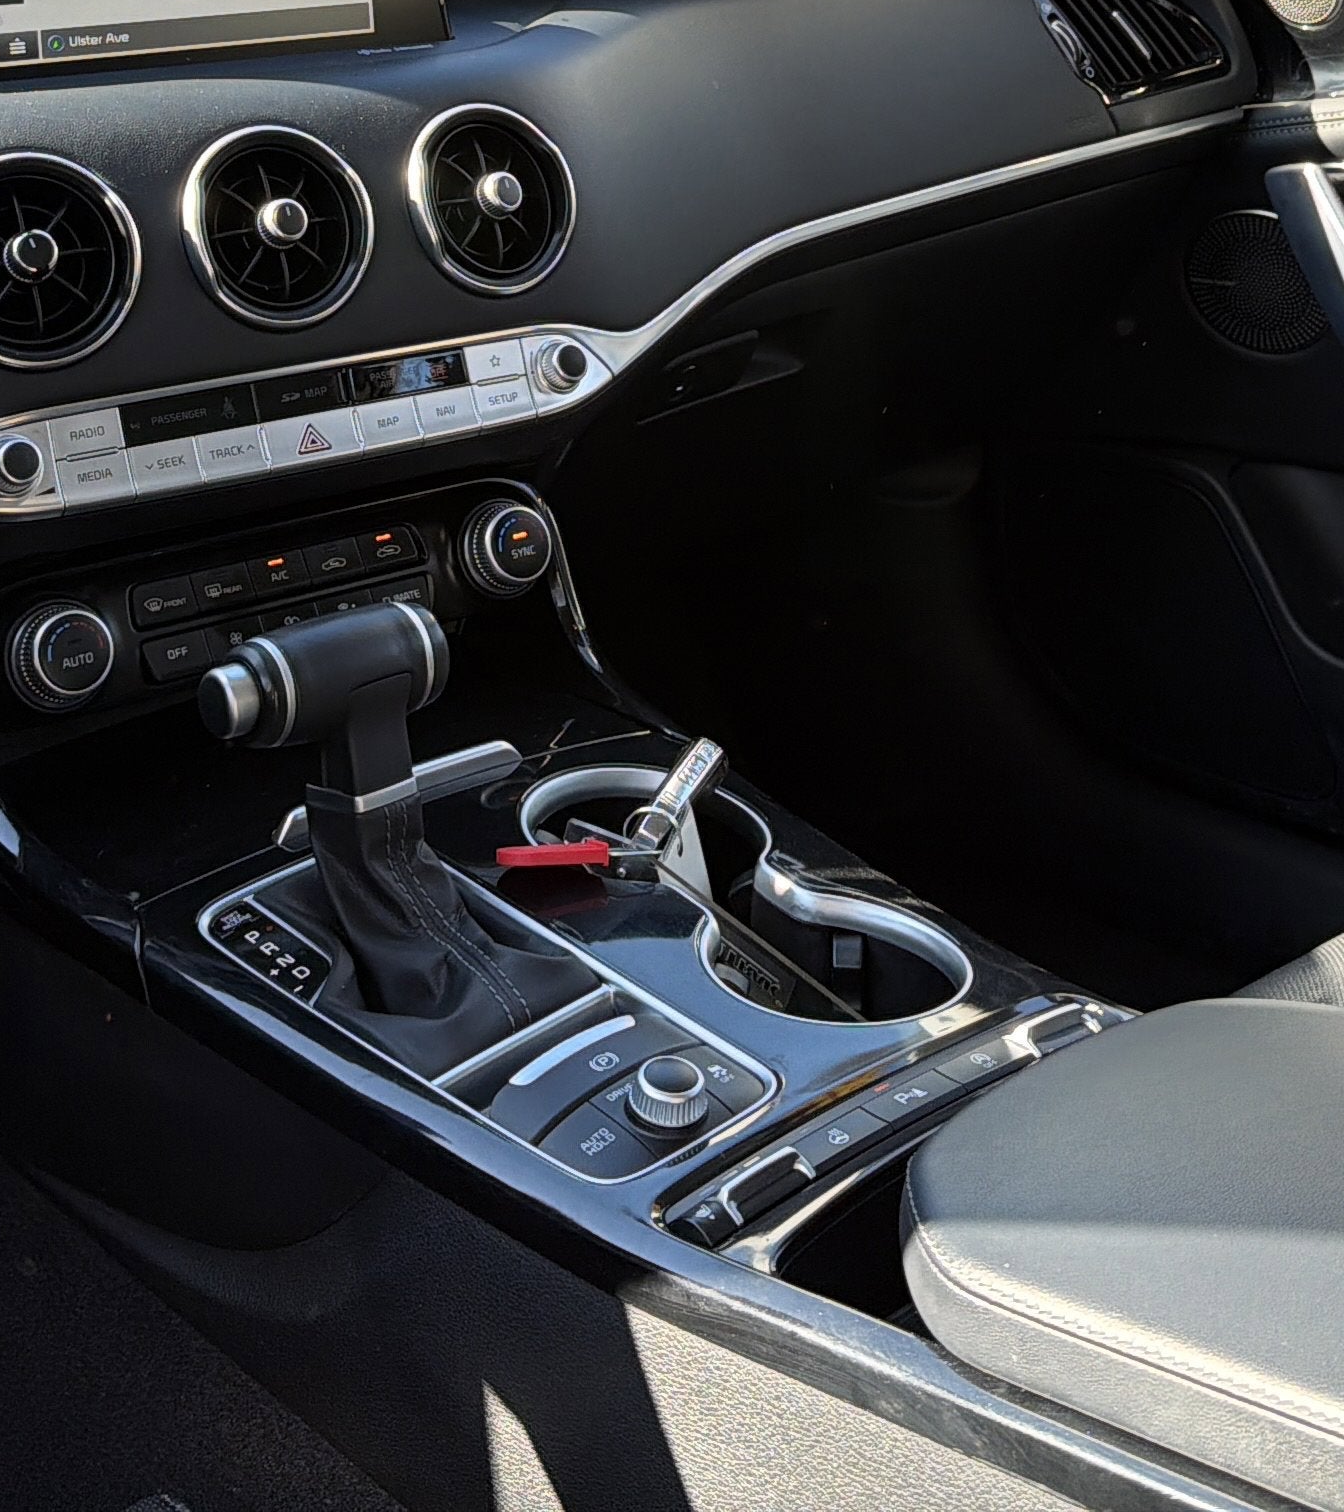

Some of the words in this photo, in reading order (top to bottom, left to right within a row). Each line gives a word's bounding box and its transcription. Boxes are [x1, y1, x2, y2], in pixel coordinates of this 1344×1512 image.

[69, 35, 102, 48] Ulster
[105, 32, 130, 44] Ave
[304, 385, 327, 399] MAP
[489, 392, 518, 406] SETUP
[150, 406, 207, 427] PASSENGER
[435, 404, 456, 418] NAV
[377, 415, 400, 429] MAP
[69, 425, 105, 442] RADIO
[209, 445, 245, 460] TRACK
[157, 454, 186, 471] SEEK
[77, 467, 113, 485] MEDIA
[511, 545, 536, 560] SYNC
[271, 570, 289, 582] A/C
[222, 584, 243, 594] REAR
[382, 588, 422, 603] CLIMATE
[163, 597, 187, 608] FRONT
[167, 646, 188, 660] OFF
[62, 651, 94, 671] AUTO
[244, 930, 260, 944] P
[259, 941, 280, 956] R
[276, 953, 296, 967] N
[291, 966, 310, 979] D
[606, 1082, 634, 1102] DRIVE
[580, 1127, 610, 1152] AUTO
[585, 1133, 616, 1156] HOLD
